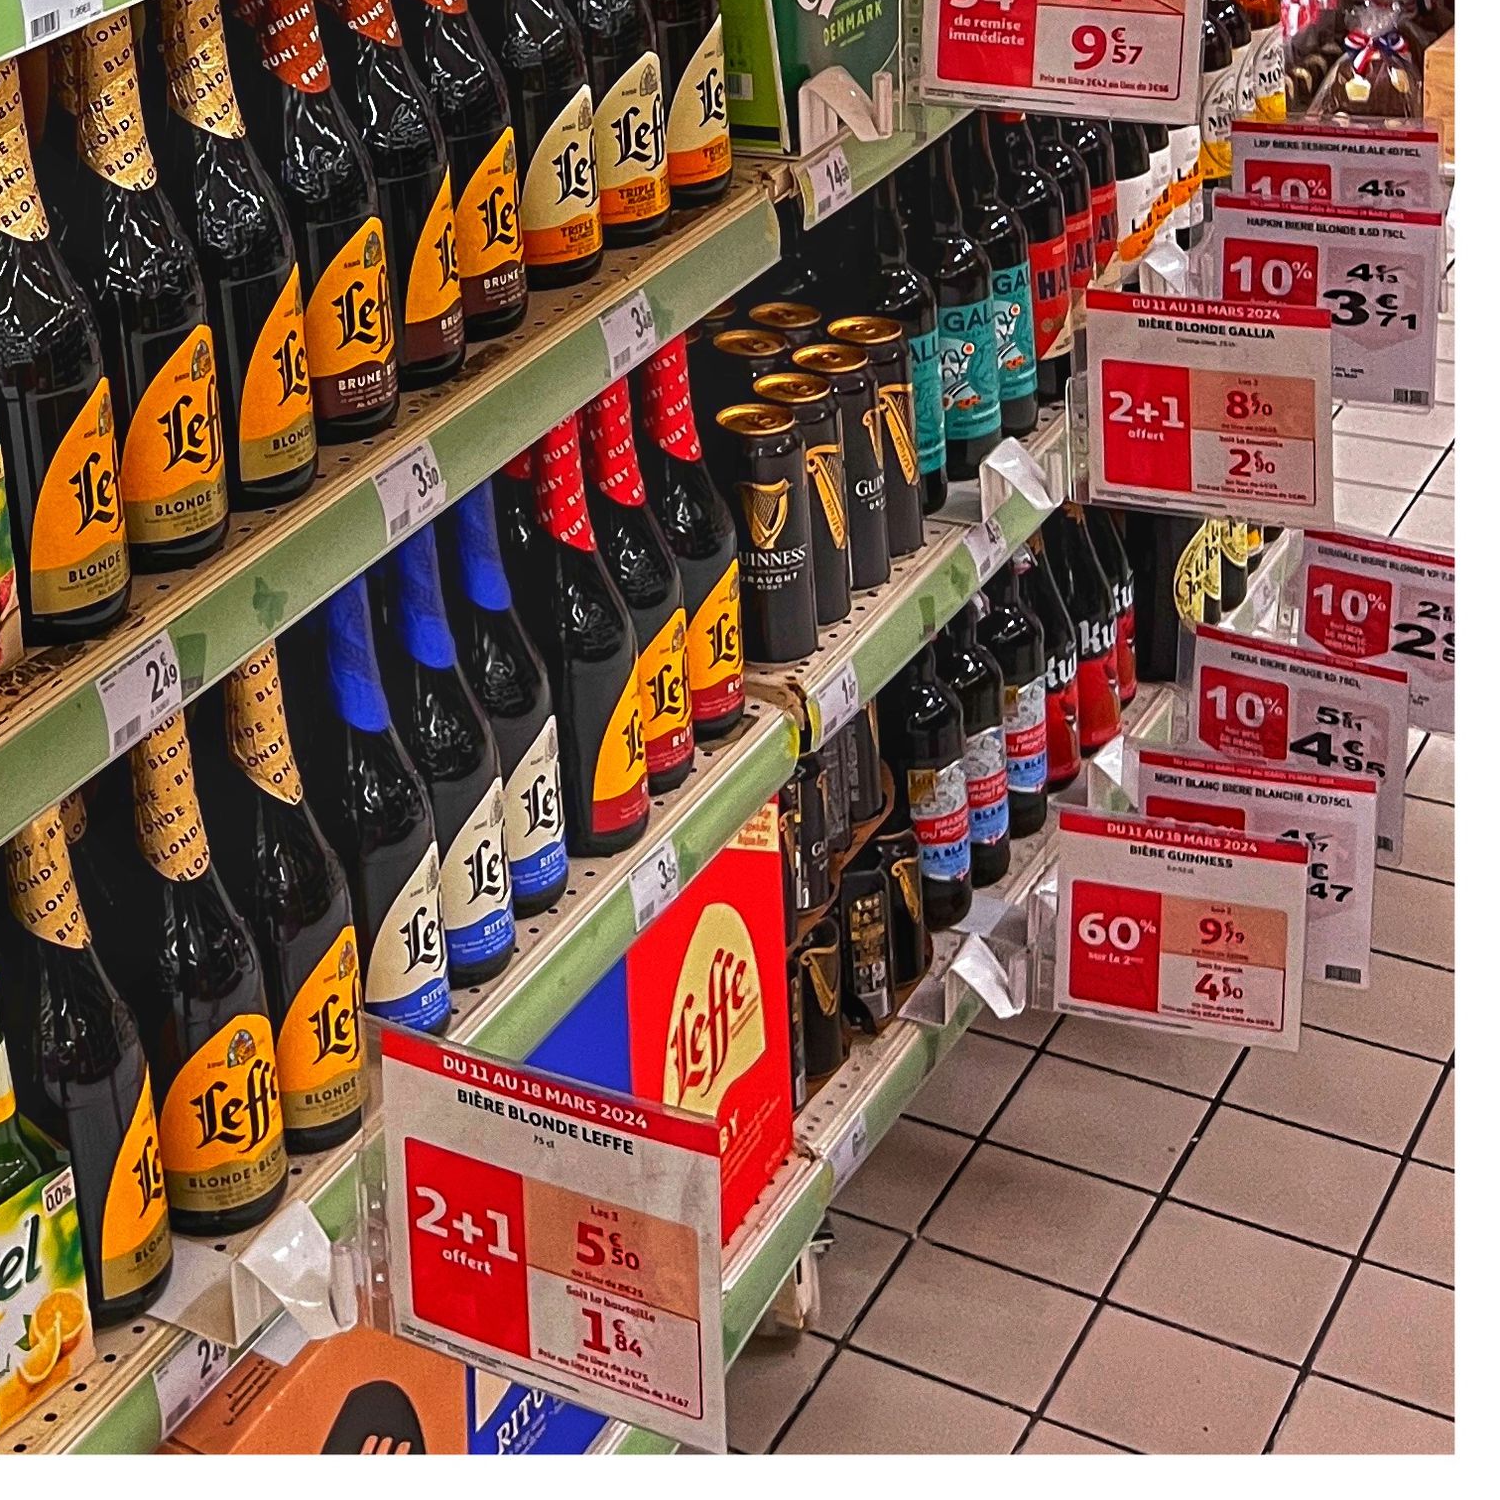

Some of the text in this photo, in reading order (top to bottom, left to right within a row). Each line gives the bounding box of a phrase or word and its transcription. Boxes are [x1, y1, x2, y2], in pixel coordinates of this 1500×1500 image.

[823, 0, 883, 48] DENMARK
[948, 26, 1025, 46] immédiate
[954, 14, 1021, 31] de remise
[1175, 321, 1226, 335] BLONDE
[1228, 327, 1275, 340] GALLIA
[1109, 390, 1185, 429] 2+1
[1128, 428, 1165, 442] offert
[1167, 851, 1233, 869] GUINNESS
[442, 1055, 649, 1129] DU 11 AU 18 MARS 2024
[457, 1088, 634, 1155] BIÈRE BLONDE LEFFE
[415, 1186, 519, 1262] 2+1
[442, 1247, 493, 1276] offert
